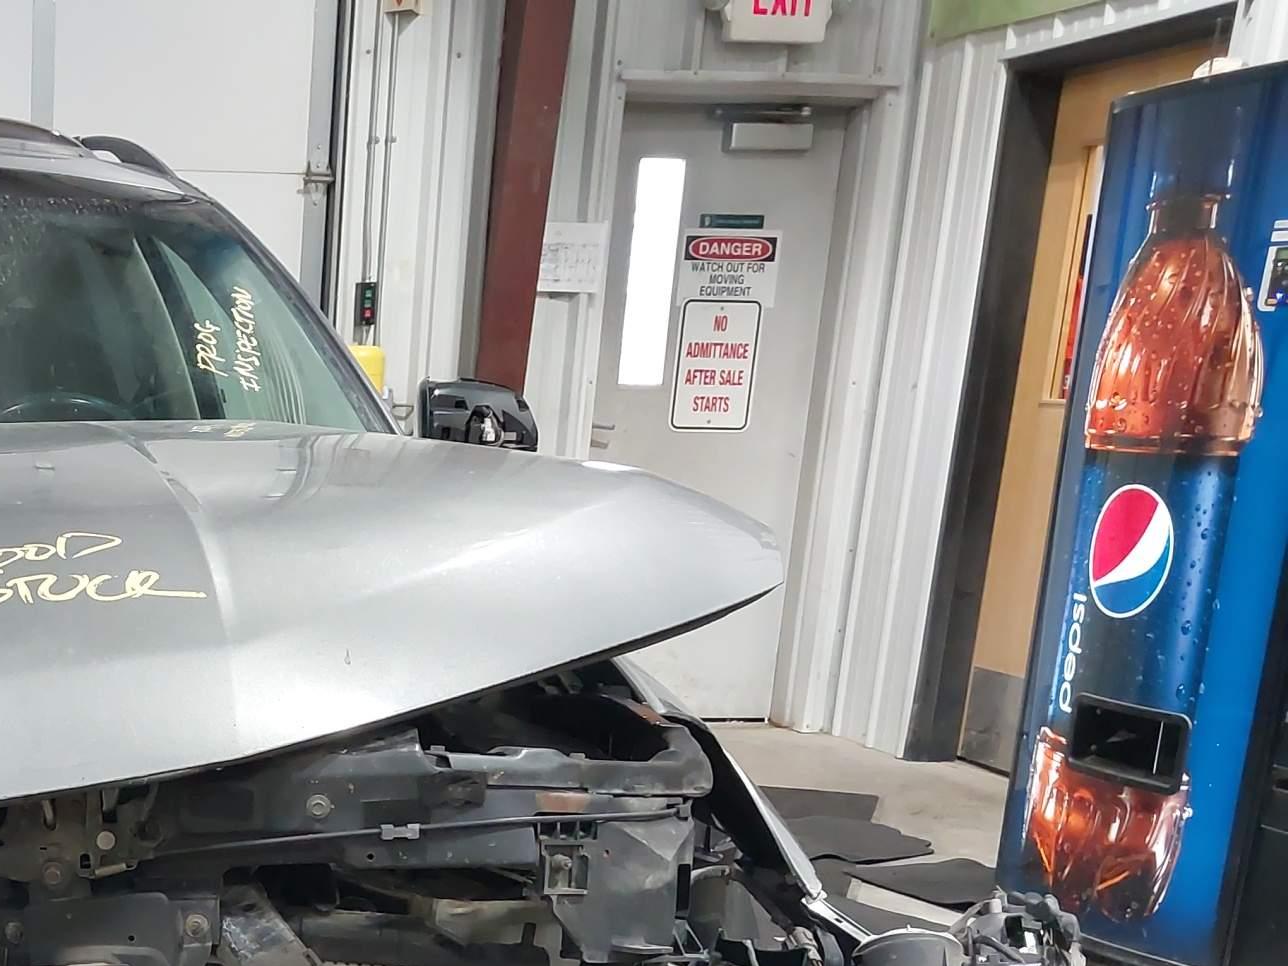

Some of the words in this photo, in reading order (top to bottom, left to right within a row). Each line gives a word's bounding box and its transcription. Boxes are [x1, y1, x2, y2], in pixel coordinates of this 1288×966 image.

[698, 242, 763, 256] DANGER
[691, 262, 723, 273] WATCH
[726, 262, 745, 273] OUT
[746, 262, 765, 273] FOR
[709, 274, 745, 285] MOVING
[699, 286, 752, 297] EQUIPMENT
[713, 315, 728, 332] NO
[230, 286, 261, 392] INSPECTION
[686, 342, 749, 360] ADMITTANCE
[685, 369, 716, 386] AFTER
[718, 369, 744, 386] SALE
[692, 396, 730, 413] STARTS
[1059, 592, 1088, 714] pepsi
